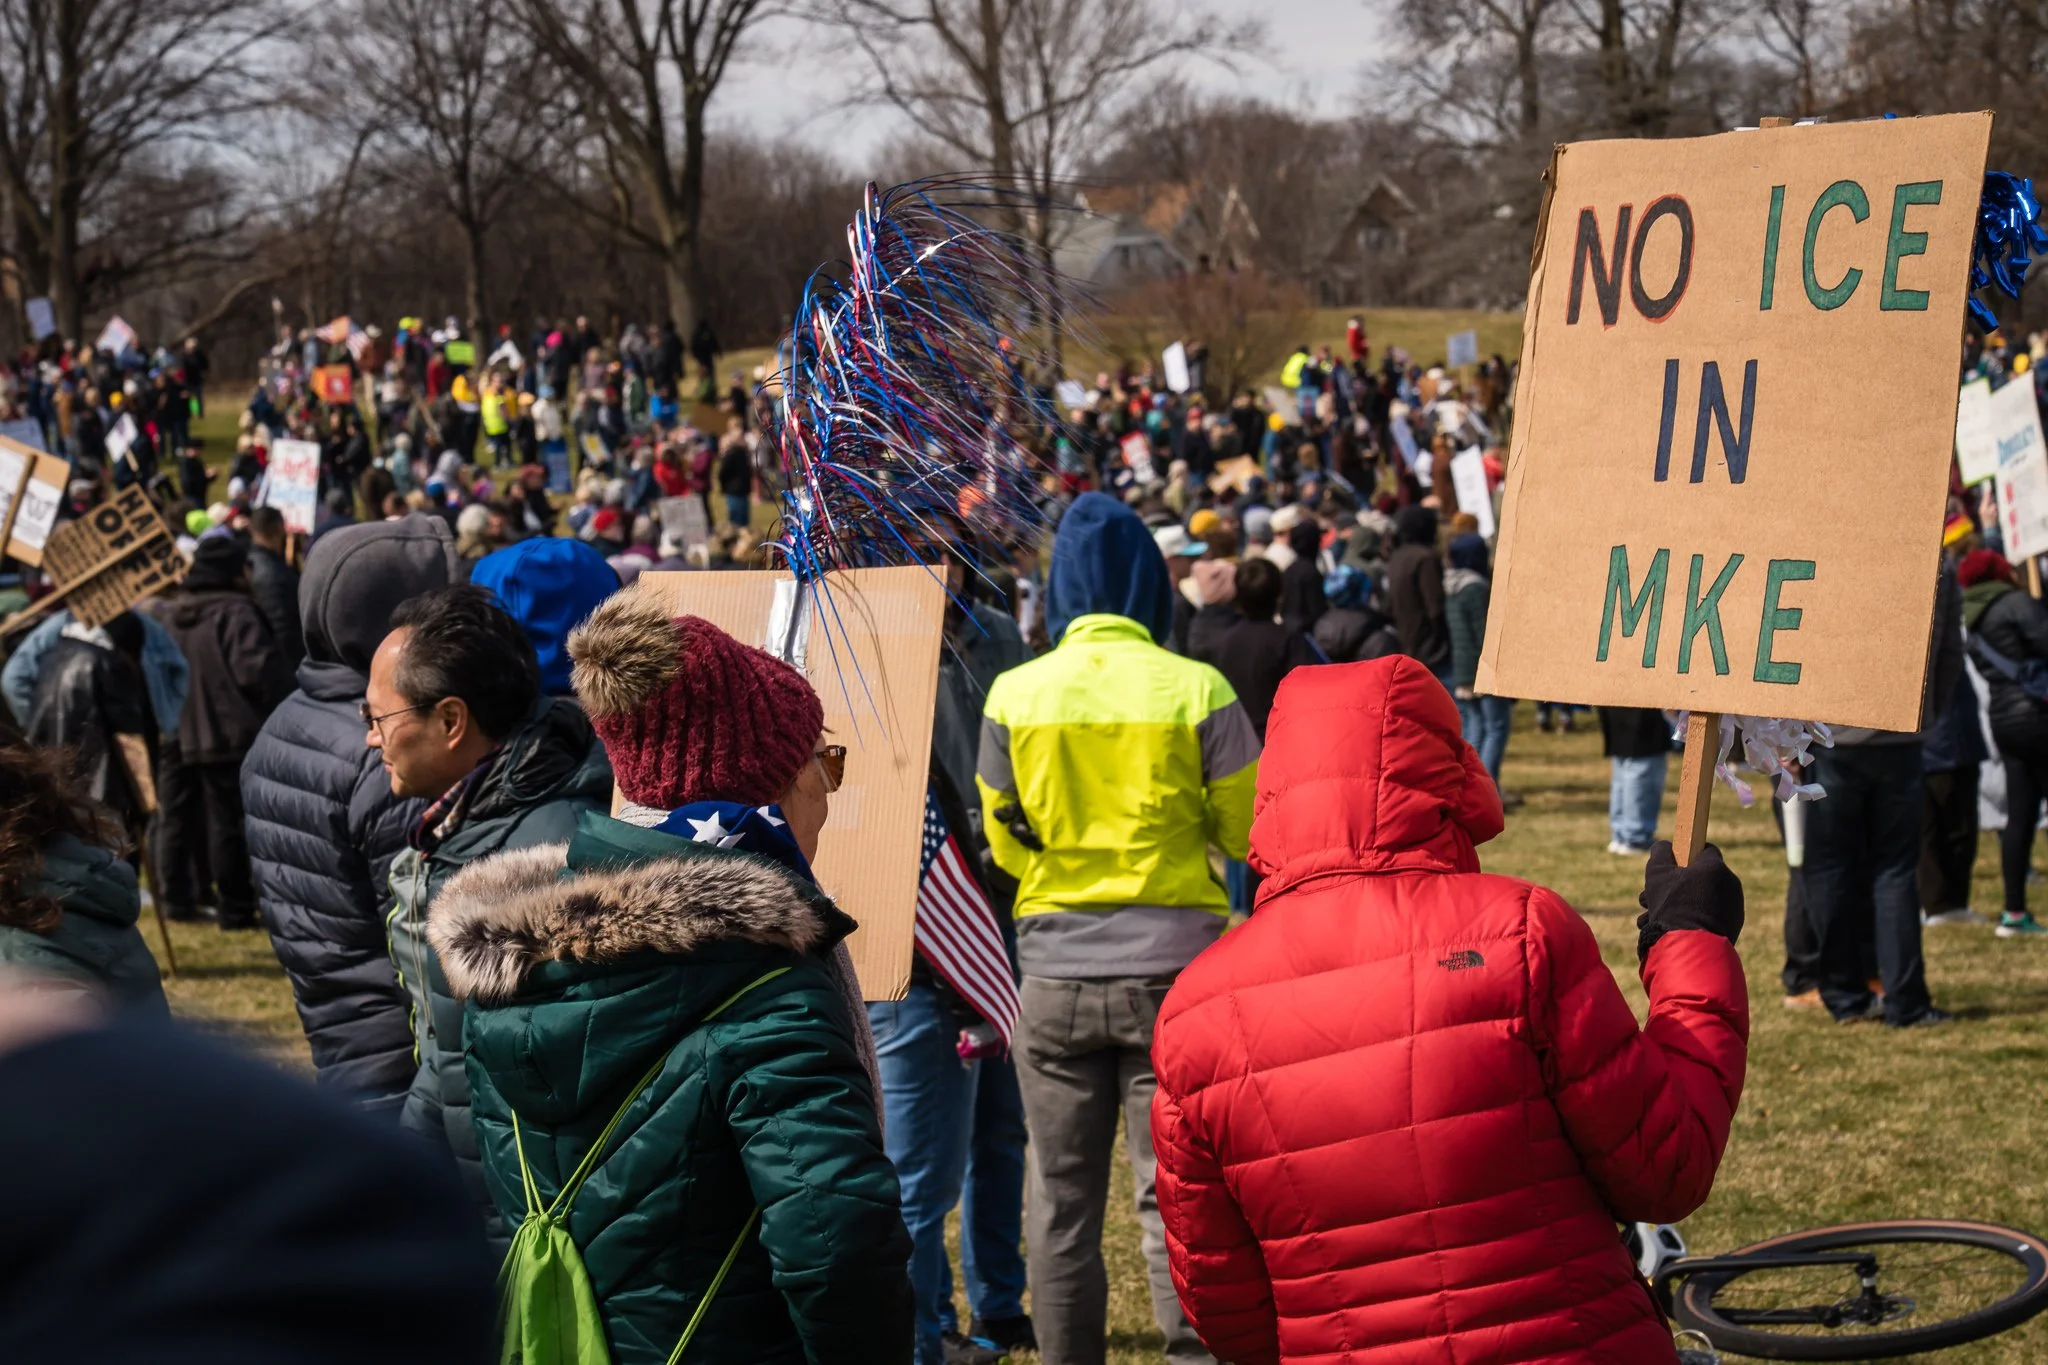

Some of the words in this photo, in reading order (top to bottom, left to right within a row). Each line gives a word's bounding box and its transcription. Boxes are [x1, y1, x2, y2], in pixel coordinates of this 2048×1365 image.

[1566, 193, 1695, 330] NO
[1760, 179, 1943, 312] ICE
[1653, 359, 1758, 485] IN
[1596, 544, 1816, 685] MKE
